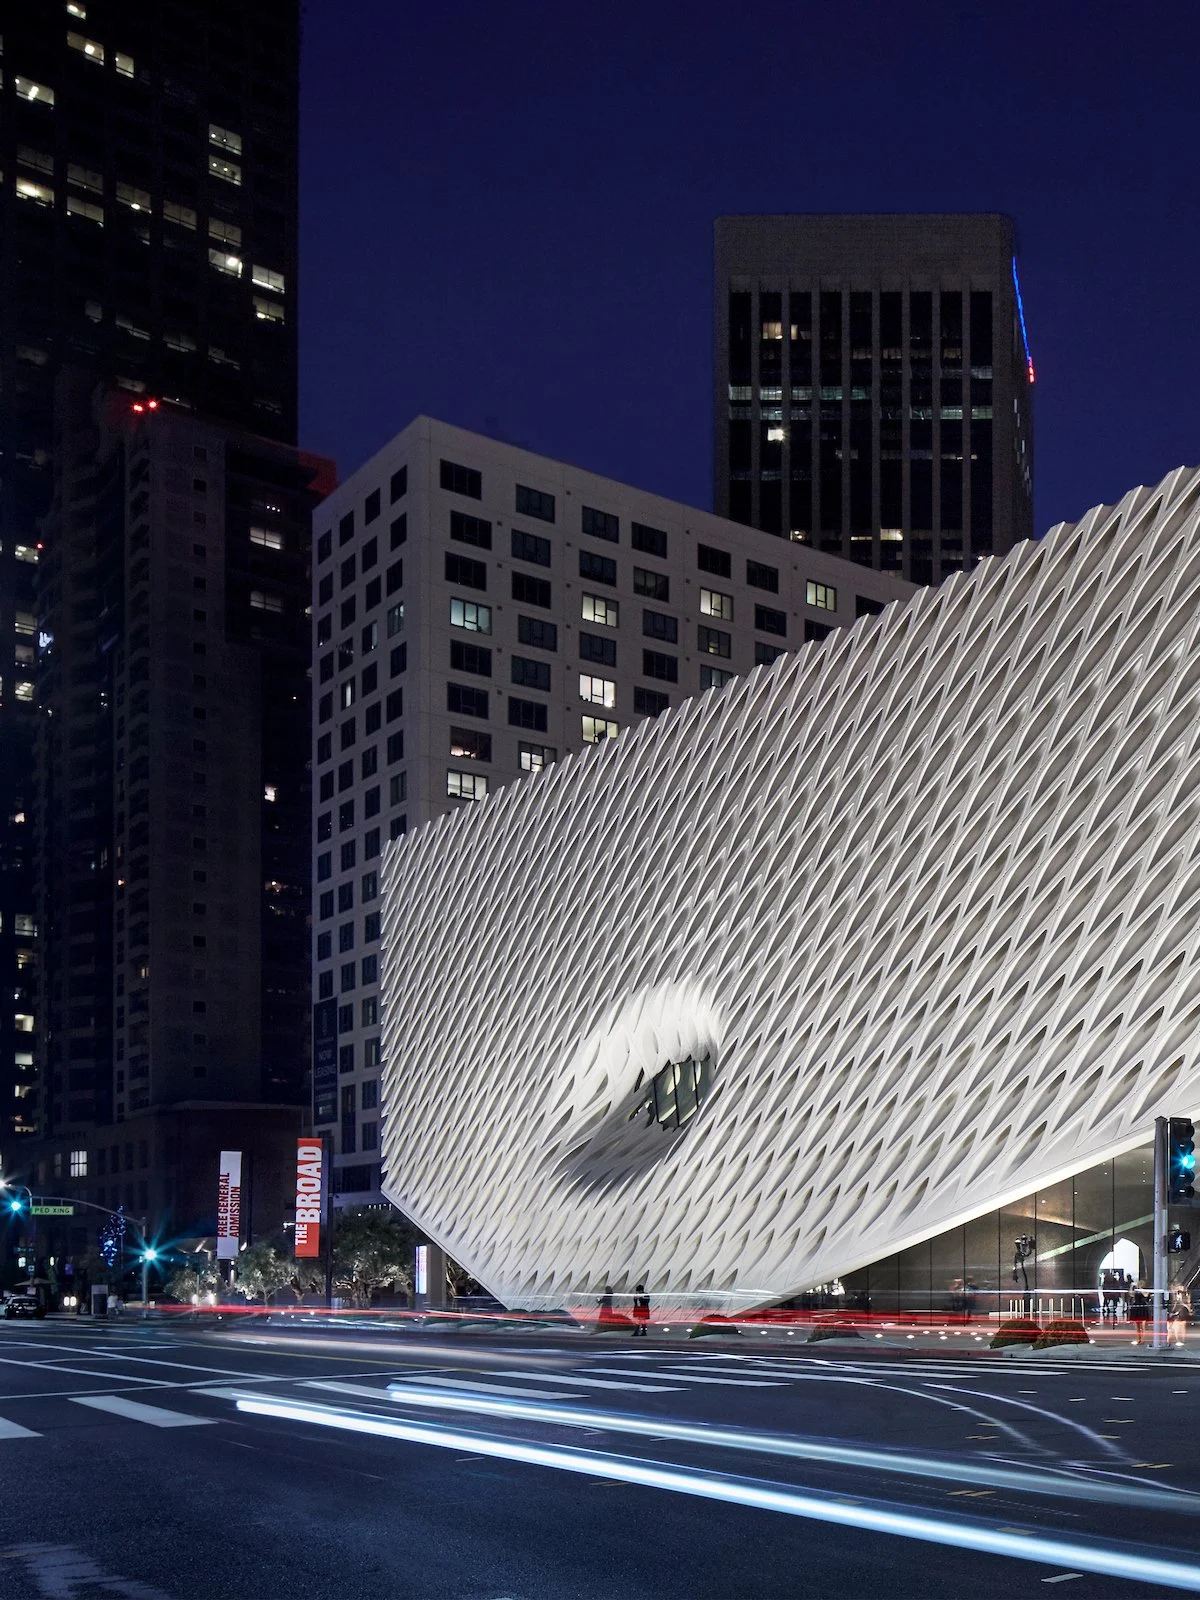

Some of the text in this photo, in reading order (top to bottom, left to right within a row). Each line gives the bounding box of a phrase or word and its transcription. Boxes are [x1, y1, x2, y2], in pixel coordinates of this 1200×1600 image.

[217, 1172, 230, 1238] FREE GENERAL
[229, 1186, 241, 1237] ADMISSION
[295, 1146, 321, 1245] THE BROAD
